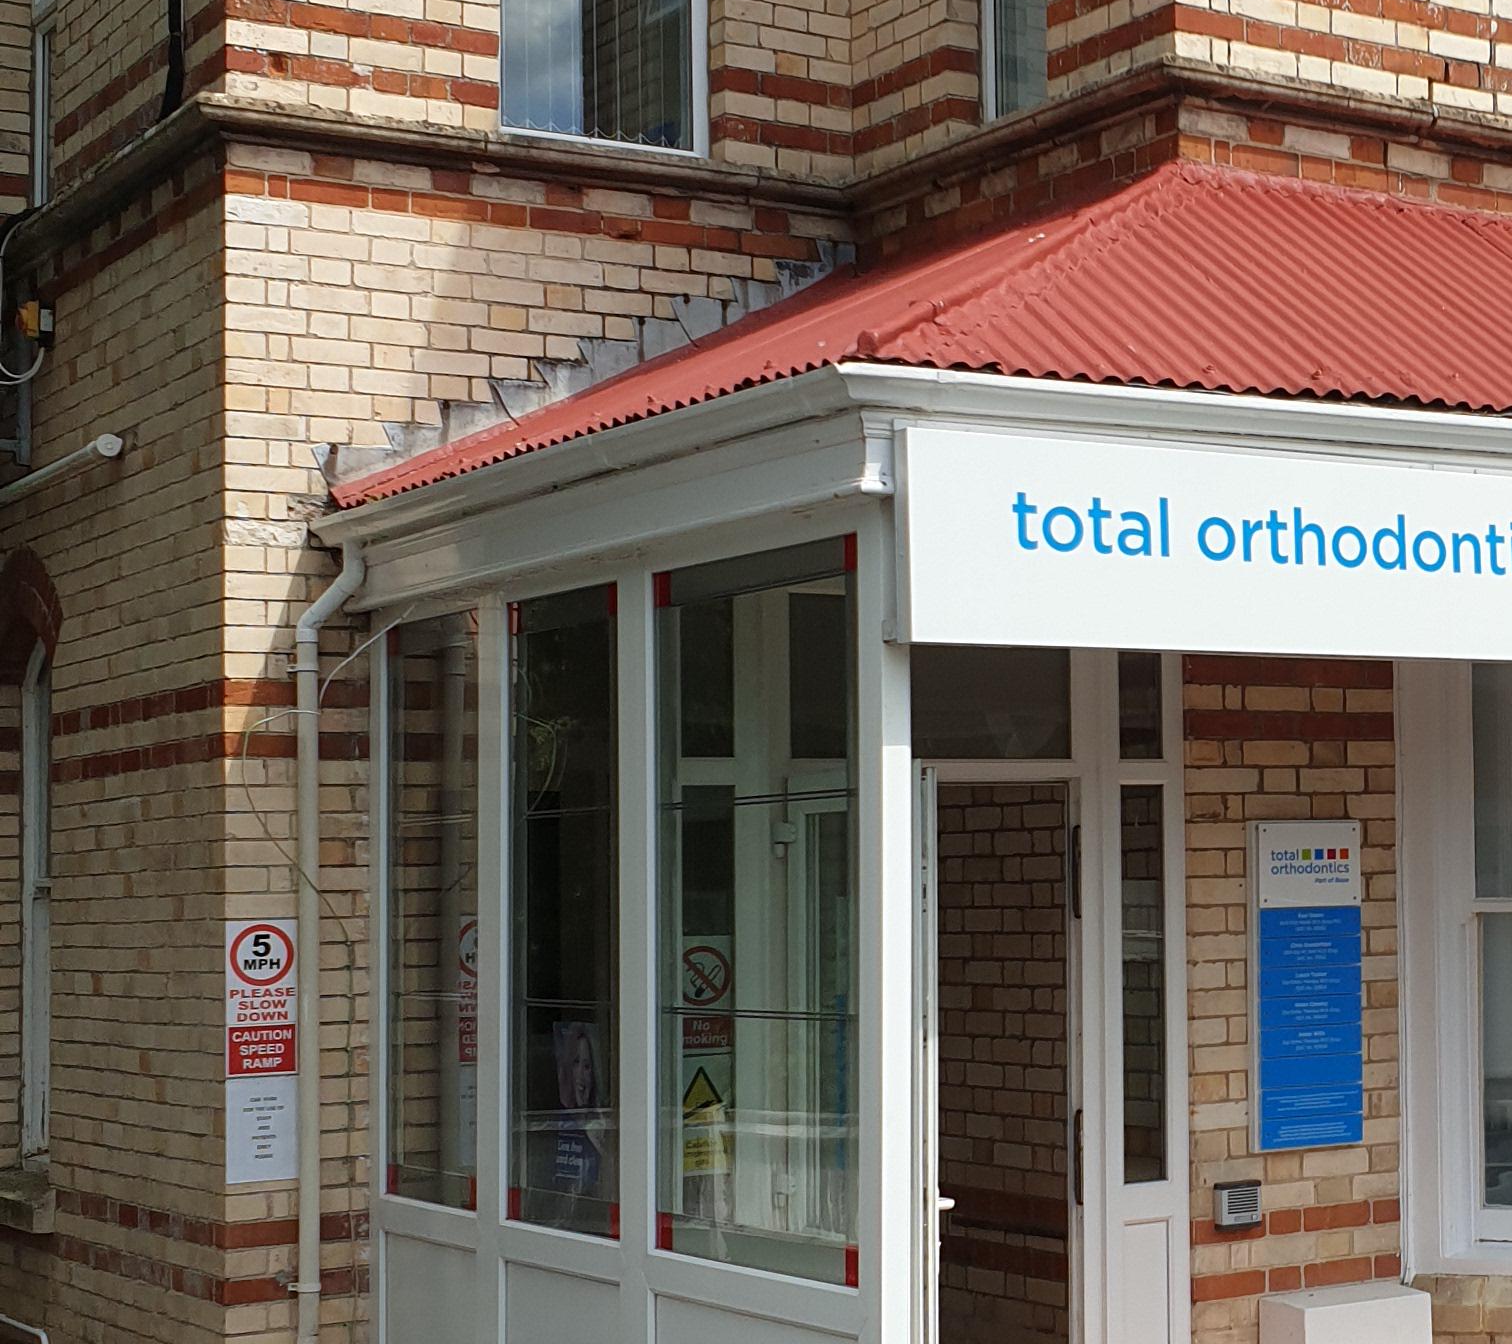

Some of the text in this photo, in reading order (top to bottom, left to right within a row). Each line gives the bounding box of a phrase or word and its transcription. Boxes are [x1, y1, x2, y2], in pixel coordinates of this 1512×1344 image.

[1011, 491, 1170, 558] total
[1271, 848, 1299, 862] total
[1271, 862, 1350, 876] orthodontics
[252, 934, 271, 957] 5
[243, 958, 281, 971] MPH
[229, 987, 296, 999] PLEASE
[238, 999, 287, 1011] SLOW
[236, 1011, 288, 1023] DOWN
[692, 1020, 711, 1031] No
[232, 1028, 293, 1043] CAUTION
[239, 1043, 285, 1056] SPEED
[243, 1057, 282, 1069] RAMP
